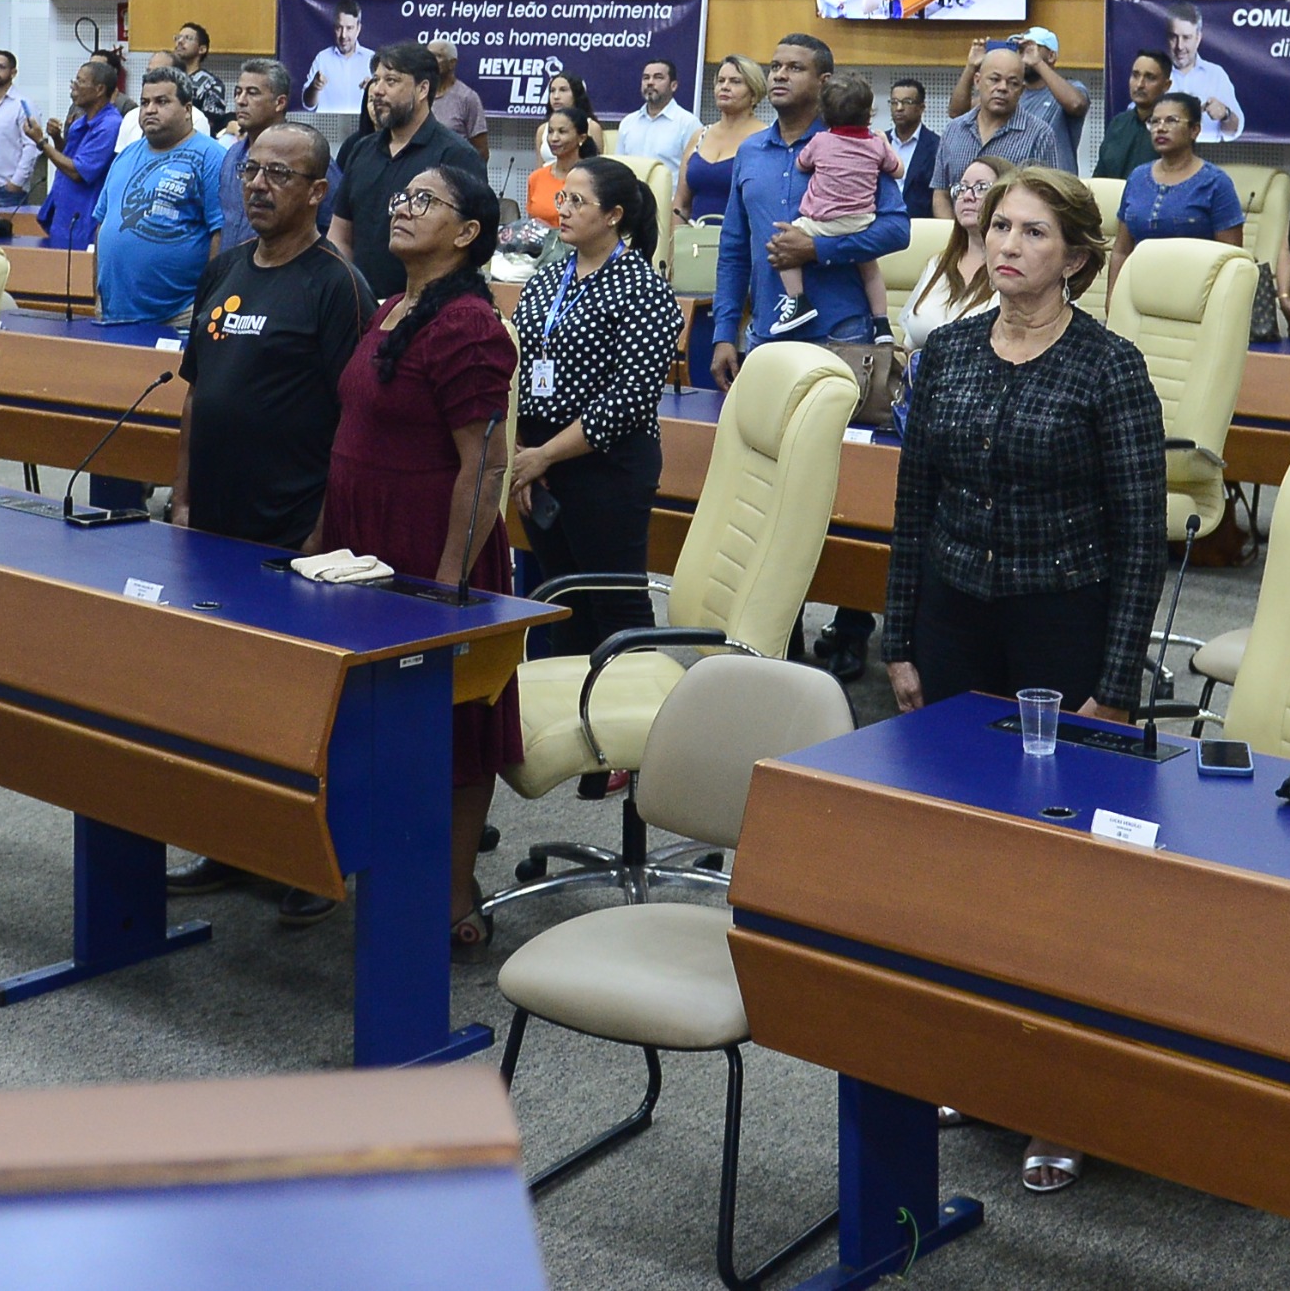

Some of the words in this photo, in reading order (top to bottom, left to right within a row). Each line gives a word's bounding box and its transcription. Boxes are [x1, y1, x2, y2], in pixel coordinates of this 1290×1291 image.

[401, 0, 415, 17] O
[418, 3, 447, 18] ver.
[451, 0, 504, 23] Heyler
[507, 1, 548, 18] Leão
[551, 1, 673, 24] cumprimenta
[417, 30, 429, 44] a
[433, 27, 480, 46] todos
[484, 30, 505, 46] os
[508, 28, 652, 52] homenageados!
[478, 58, 545, 76] HEYLER
